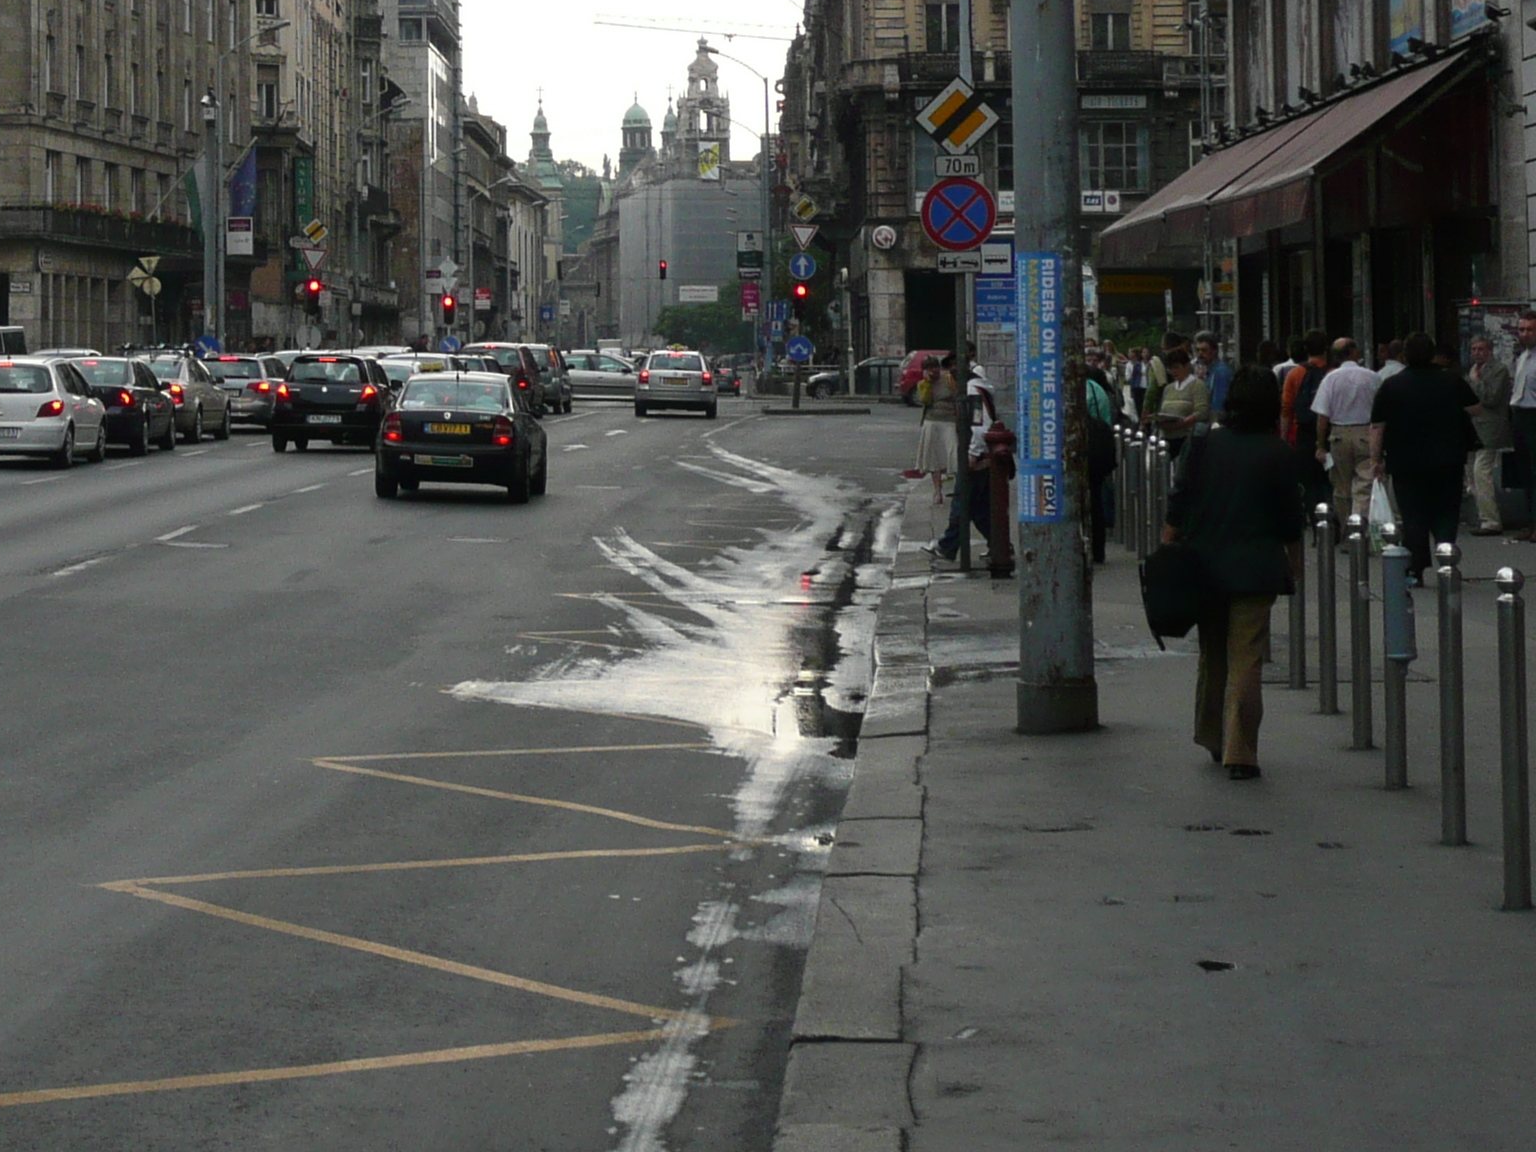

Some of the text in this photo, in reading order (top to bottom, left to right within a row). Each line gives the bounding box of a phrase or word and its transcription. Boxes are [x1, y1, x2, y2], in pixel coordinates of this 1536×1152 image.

[945, 158, 976, 174] 70 m
[1028, 258, 1041, 460] MANZAREK KRIEGER
[1042, 258, 1056, 460] RIDERS ON THE STORM
